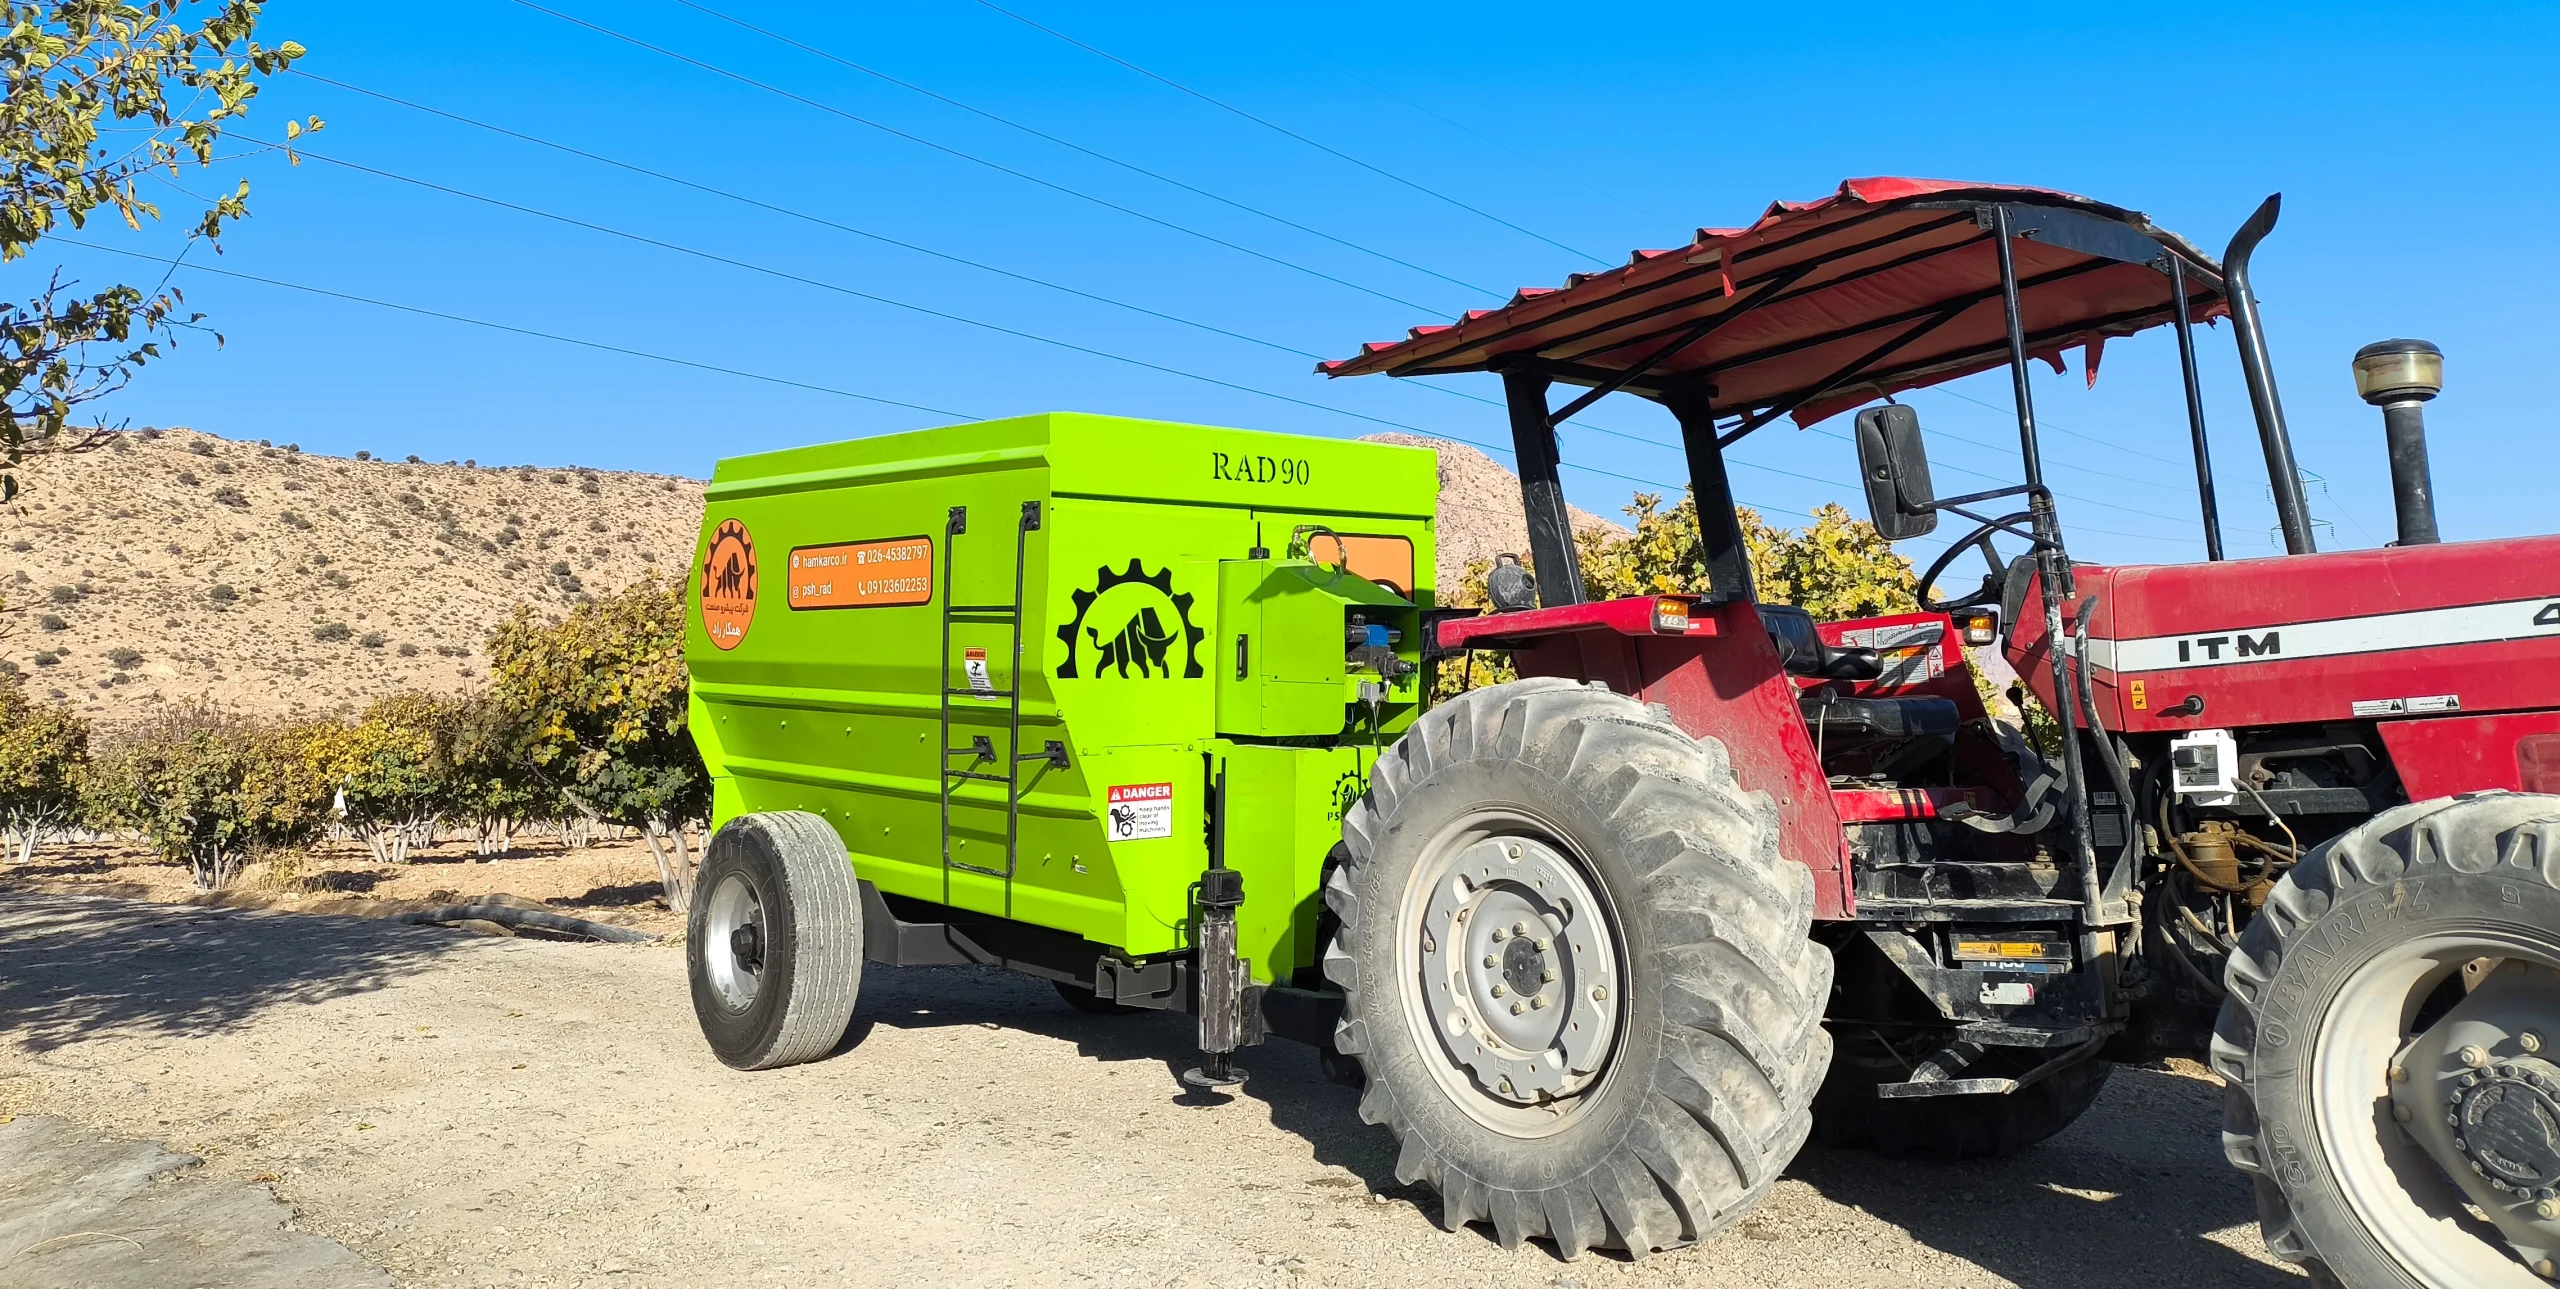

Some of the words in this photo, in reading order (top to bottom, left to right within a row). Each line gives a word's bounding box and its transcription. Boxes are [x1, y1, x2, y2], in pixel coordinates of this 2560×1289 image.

[1212, 452, 1276, 483] RAD
[1281, 458, 1310, 486] 90
[802, 552, 848, 568] hamkarco.ir
[867, 545, 929, 564] 026-45382797
[802, 580, 832, 599] psh_rad
[867, 577, 928, 594] 09123602253
[2178, 632, 2280, 662] ITM
[1123, 786, 1170, 799] DANGER
[1327, 811, 1341, 821] PS
[1363, 869, 1383, 927] SERVICE
[2272, 881, 2430, 1021] BAREZ
[2270, 1120, 2307, 1189] G10
